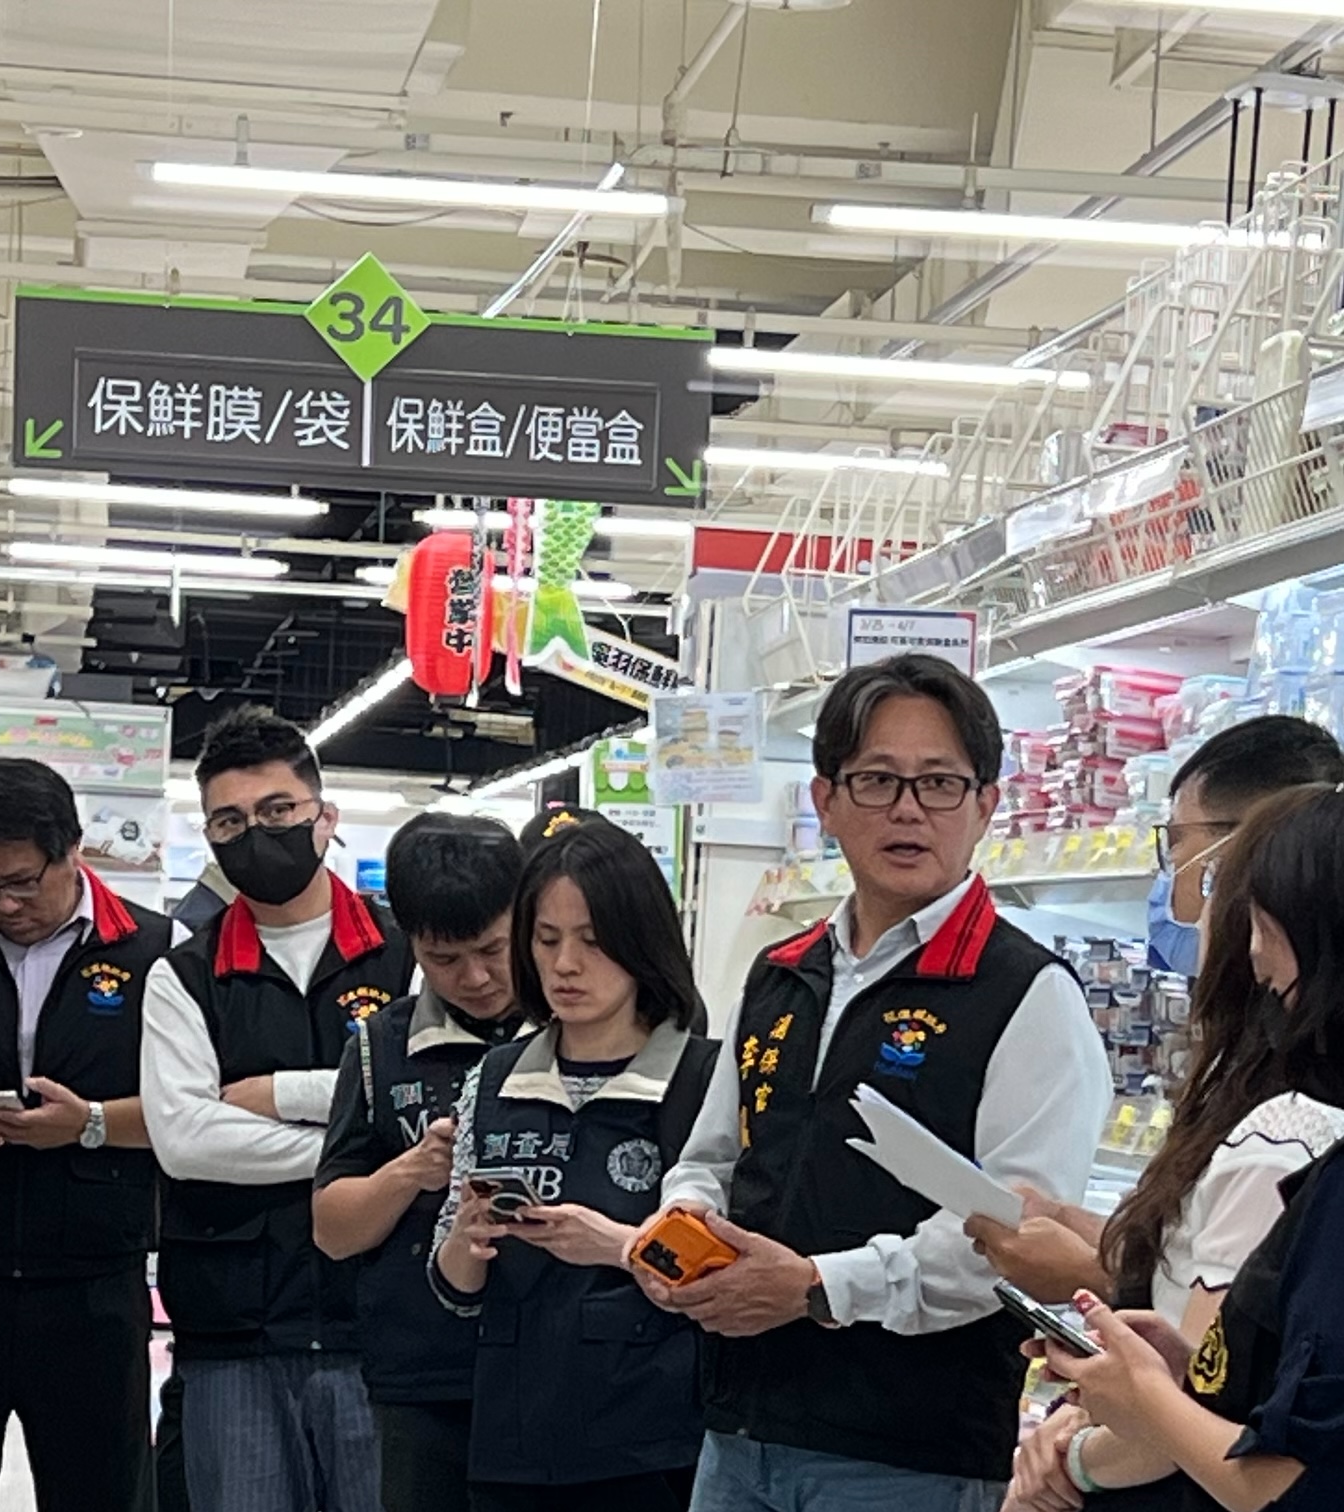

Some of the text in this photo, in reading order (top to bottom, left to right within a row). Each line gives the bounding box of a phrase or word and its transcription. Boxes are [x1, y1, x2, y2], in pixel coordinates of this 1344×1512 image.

[326, 292, 411, 345] 34
[87, 376, 351, 449] 保鮮膜/袋
[387, 396, 644, 465] 保鮮盒/便當盒
[482, 1130, 574, 1162] 調查局
